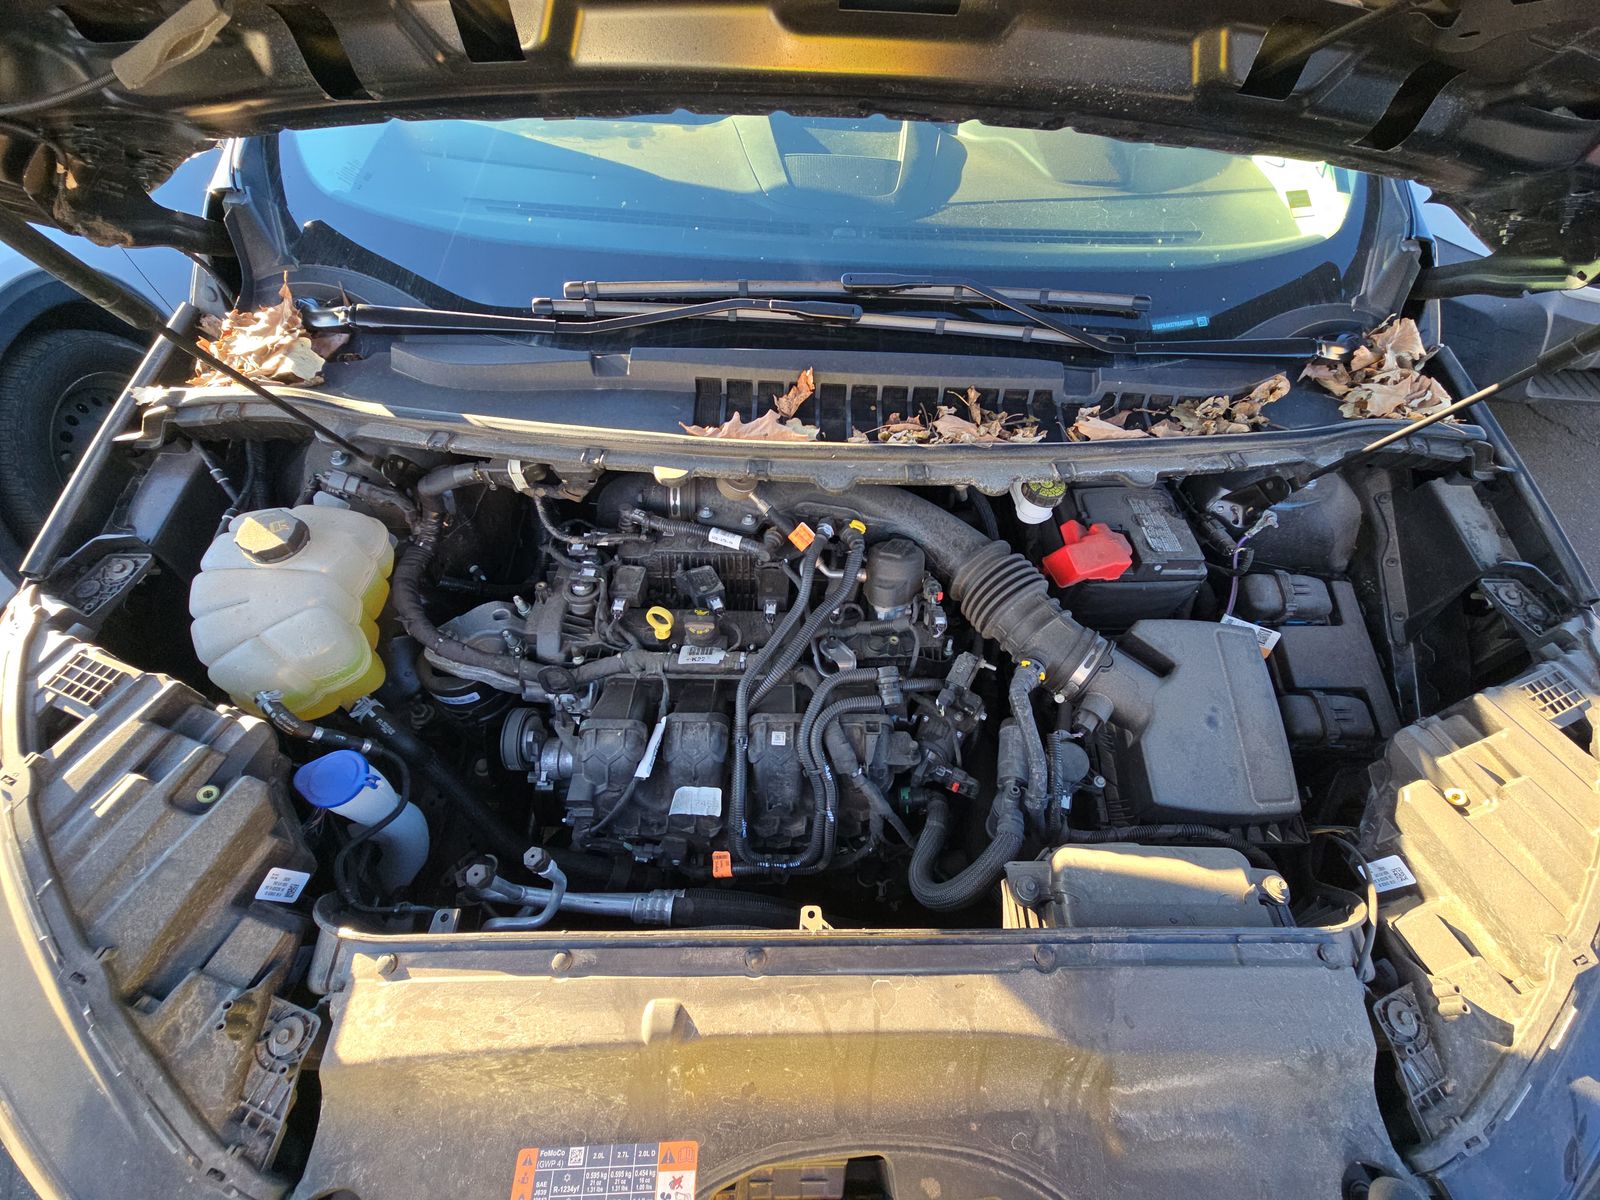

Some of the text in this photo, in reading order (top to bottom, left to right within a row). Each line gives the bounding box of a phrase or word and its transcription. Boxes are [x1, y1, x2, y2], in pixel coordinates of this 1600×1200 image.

[540, 1149, 566, 1157] FoMoCo
[592, 1151, 605, 1159] 2.0L
[616, 1151, 630, 1159] 2.7L
[638, 1150, 650, 1158] 2.0L
[537, 1159, 564, 1169] (GWP 4)
[600, 1171, 608, 1180] kg
[610, 1170, 632, 1179] 0.595 kg
[634, 1169, 656, 1178] 0.454 kg
[553, 1184, 580, 1194] R-1234yf
